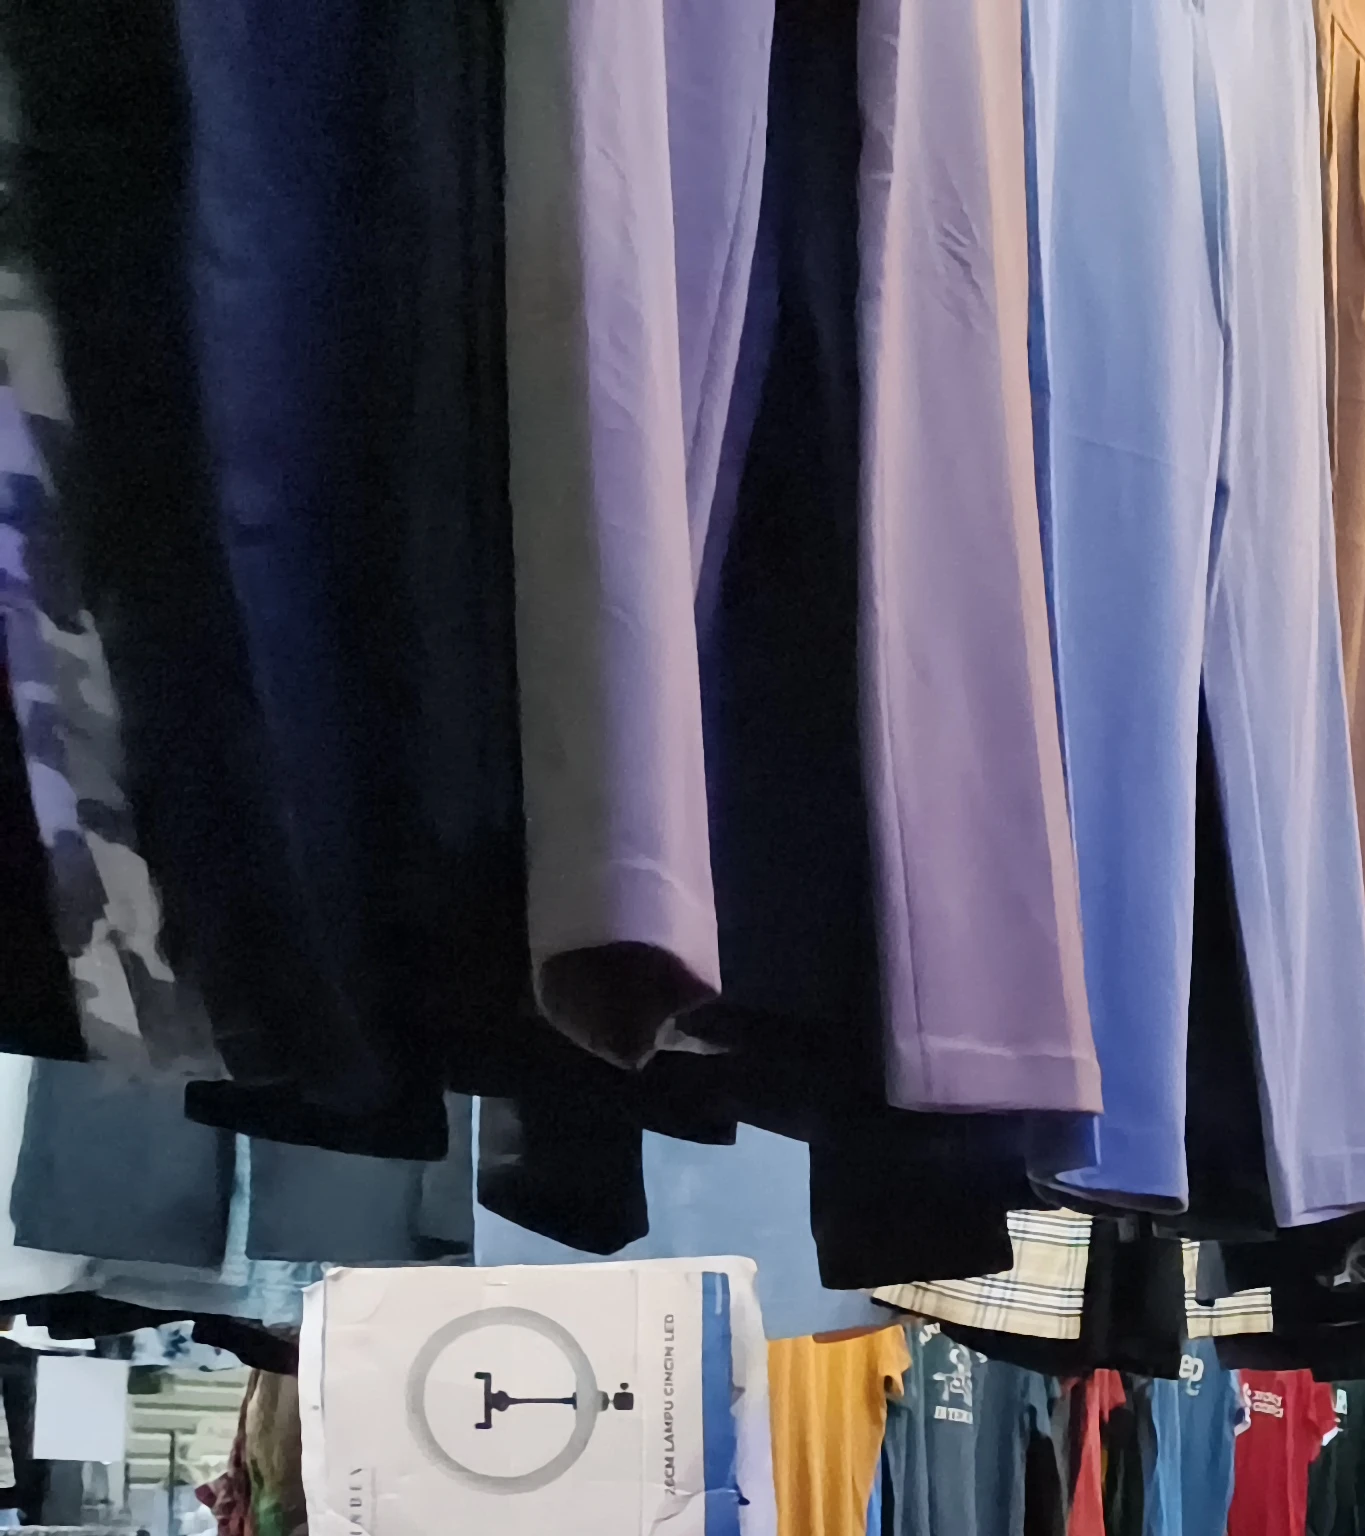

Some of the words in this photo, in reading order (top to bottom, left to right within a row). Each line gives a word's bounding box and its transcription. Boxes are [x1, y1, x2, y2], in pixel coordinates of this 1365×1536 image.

[663, 1314, 675, 1342] LED
[663, 1346, 675, 1397] CINCIN
[663, 1400, 675, 1453] LAMPU
